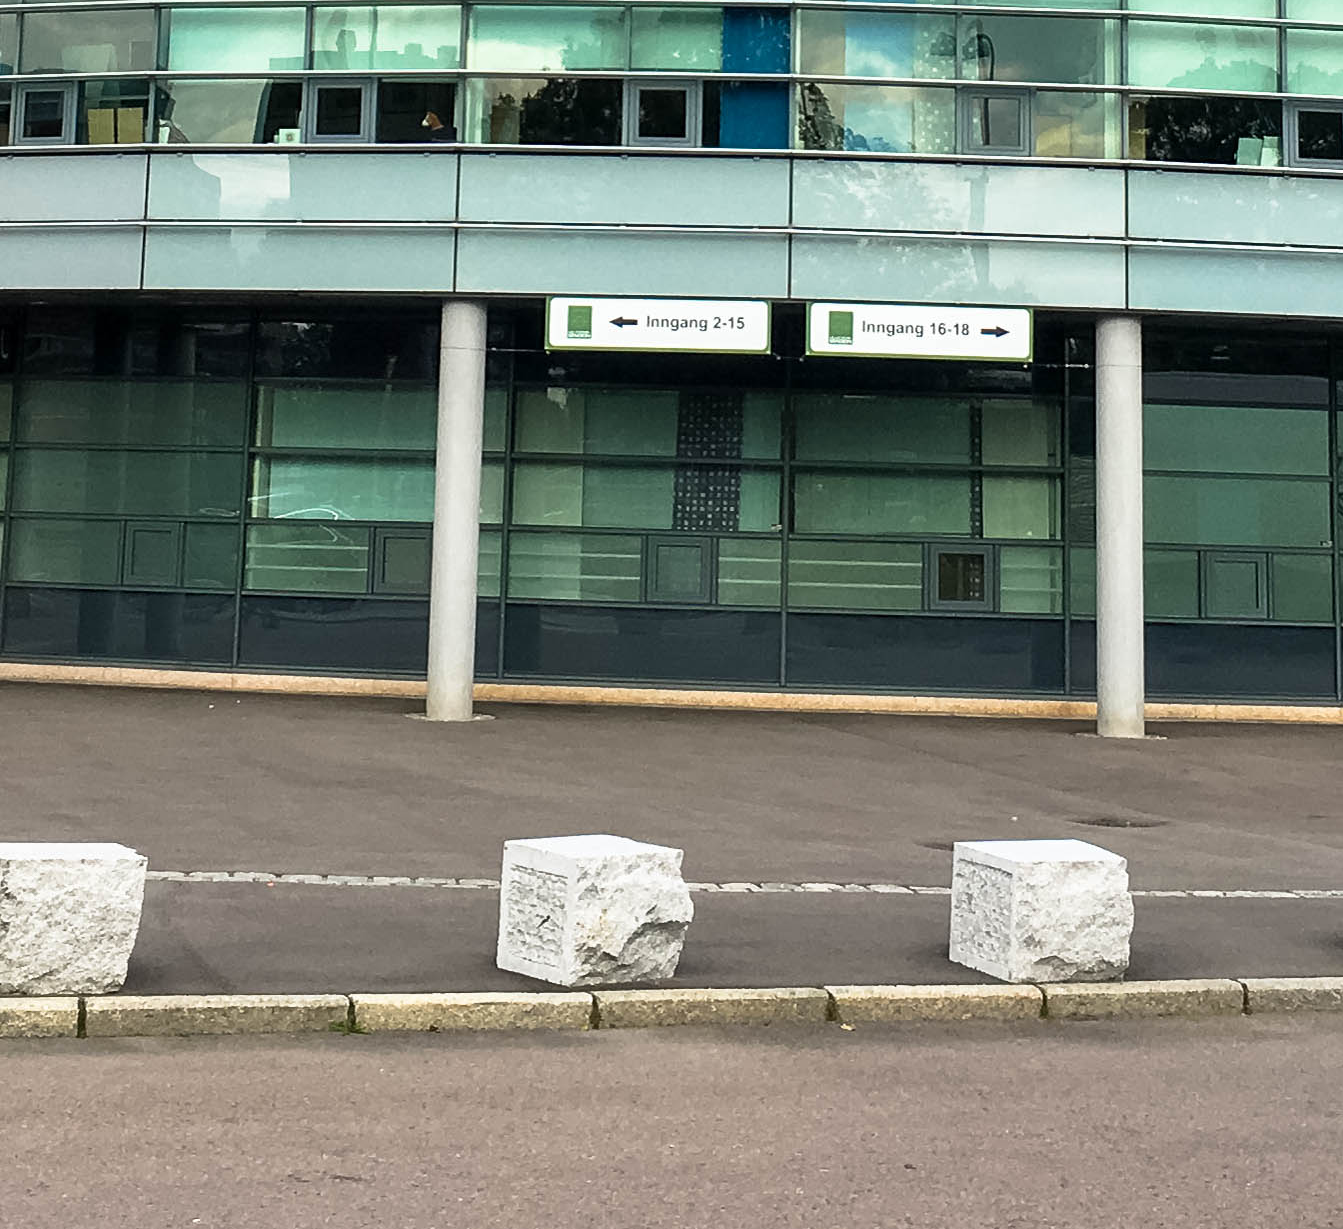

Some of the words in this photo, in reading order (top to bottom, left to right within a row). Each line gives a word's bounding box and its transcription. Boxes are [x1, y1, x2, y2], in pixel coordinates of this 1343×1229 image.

[646, 315, 708, 332] Inngang
[713, 316, 745, 330] 2-15
[862, 320, 924, 338] Inngang
[930, 322, 970, 336] 16-18
